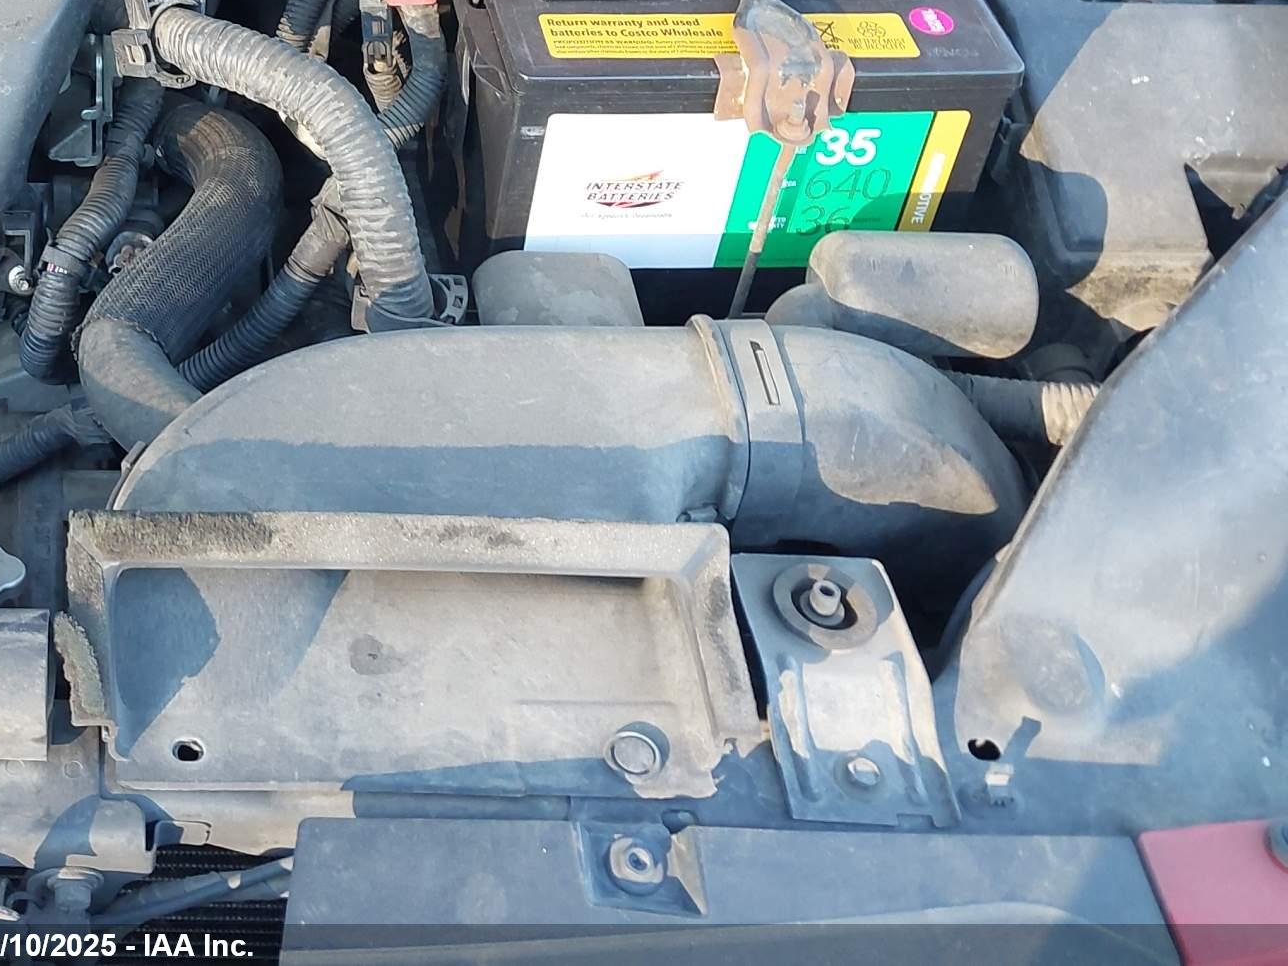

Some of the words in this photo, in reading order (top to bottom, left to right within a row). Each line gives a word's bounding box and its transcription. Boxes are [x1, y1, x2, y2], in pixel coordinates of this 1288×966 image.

[547, 18, 588, 27] Return
[590, 19, 643, 29] warranty
[646, 18, 669, 27] and
[671, 18, 700, 27] used
[550, 29, 603, 38] batteries
[606, 29, 618, 38] to
[620, 29, 659, 38] Costco
[661, 28, 724, 38] Wholesale
[815, 128, 882, 166] 35
[586, 182, 684, 191] INTERSTATE
[803, 168, 892, 200] 640
[586, 192, 674, 201] BATTERIES
